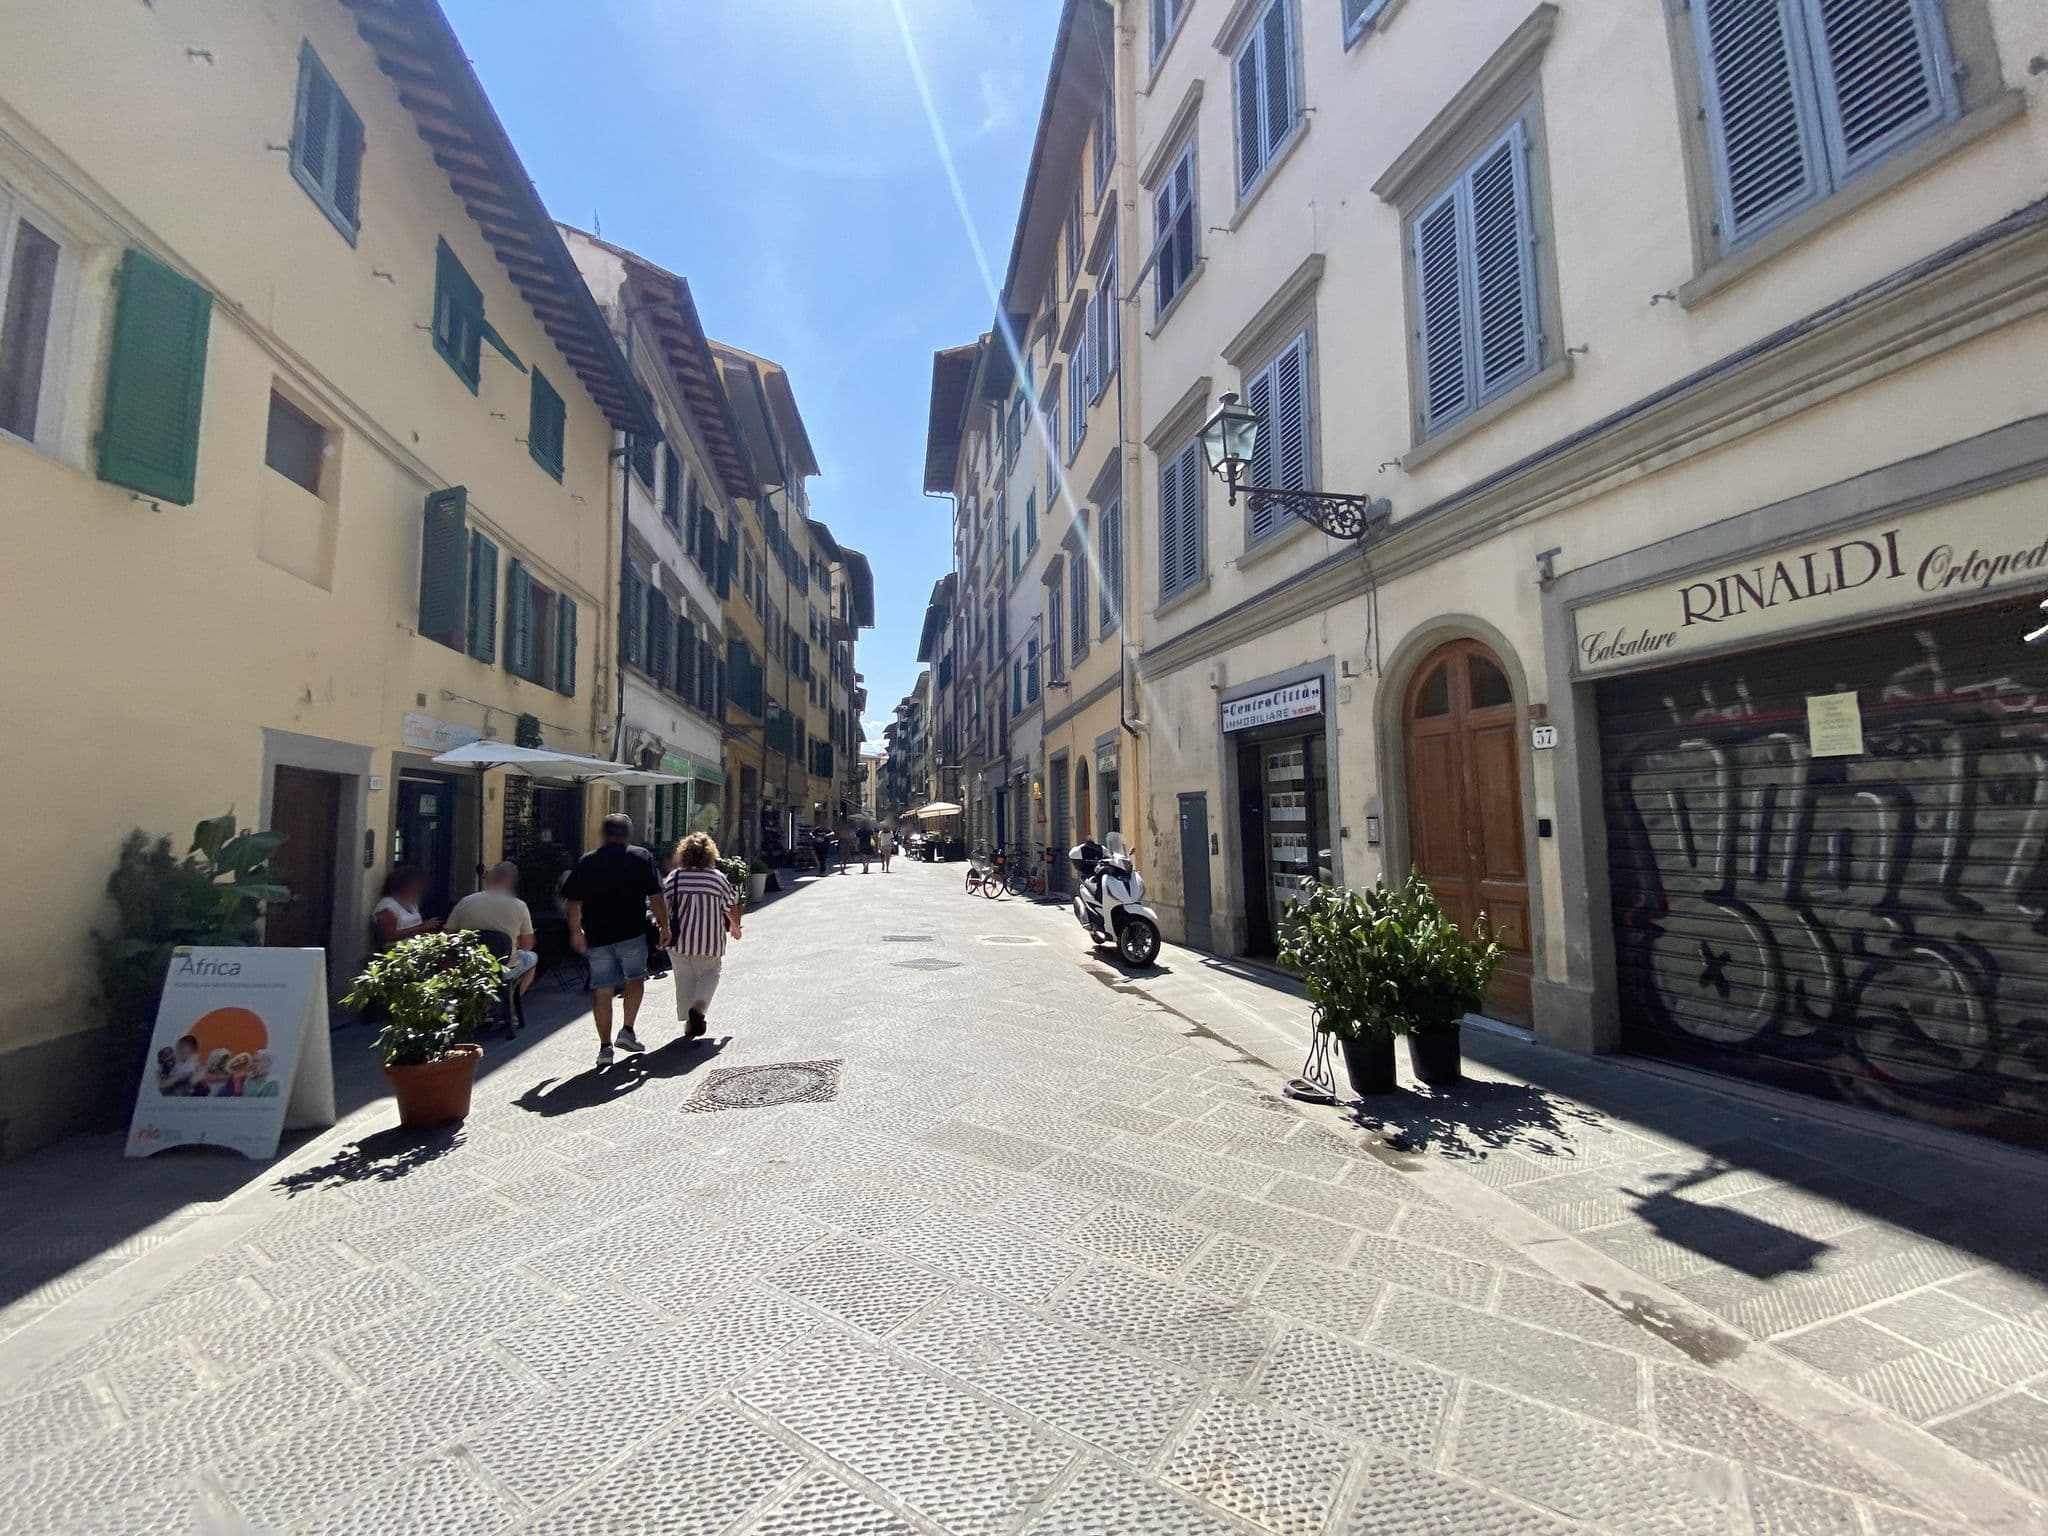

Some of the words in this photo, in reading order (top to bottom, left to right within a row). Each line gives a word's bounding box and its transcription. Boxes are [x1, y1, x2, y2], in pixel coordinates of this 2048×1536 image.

[1679, 529, 1907, 627] RINALDI
[1580, 628, 1677, 665] Calzature
[1225, 708, 1289, 729] IMMOBILIARE
[178, 958, 242, 976] Africa
